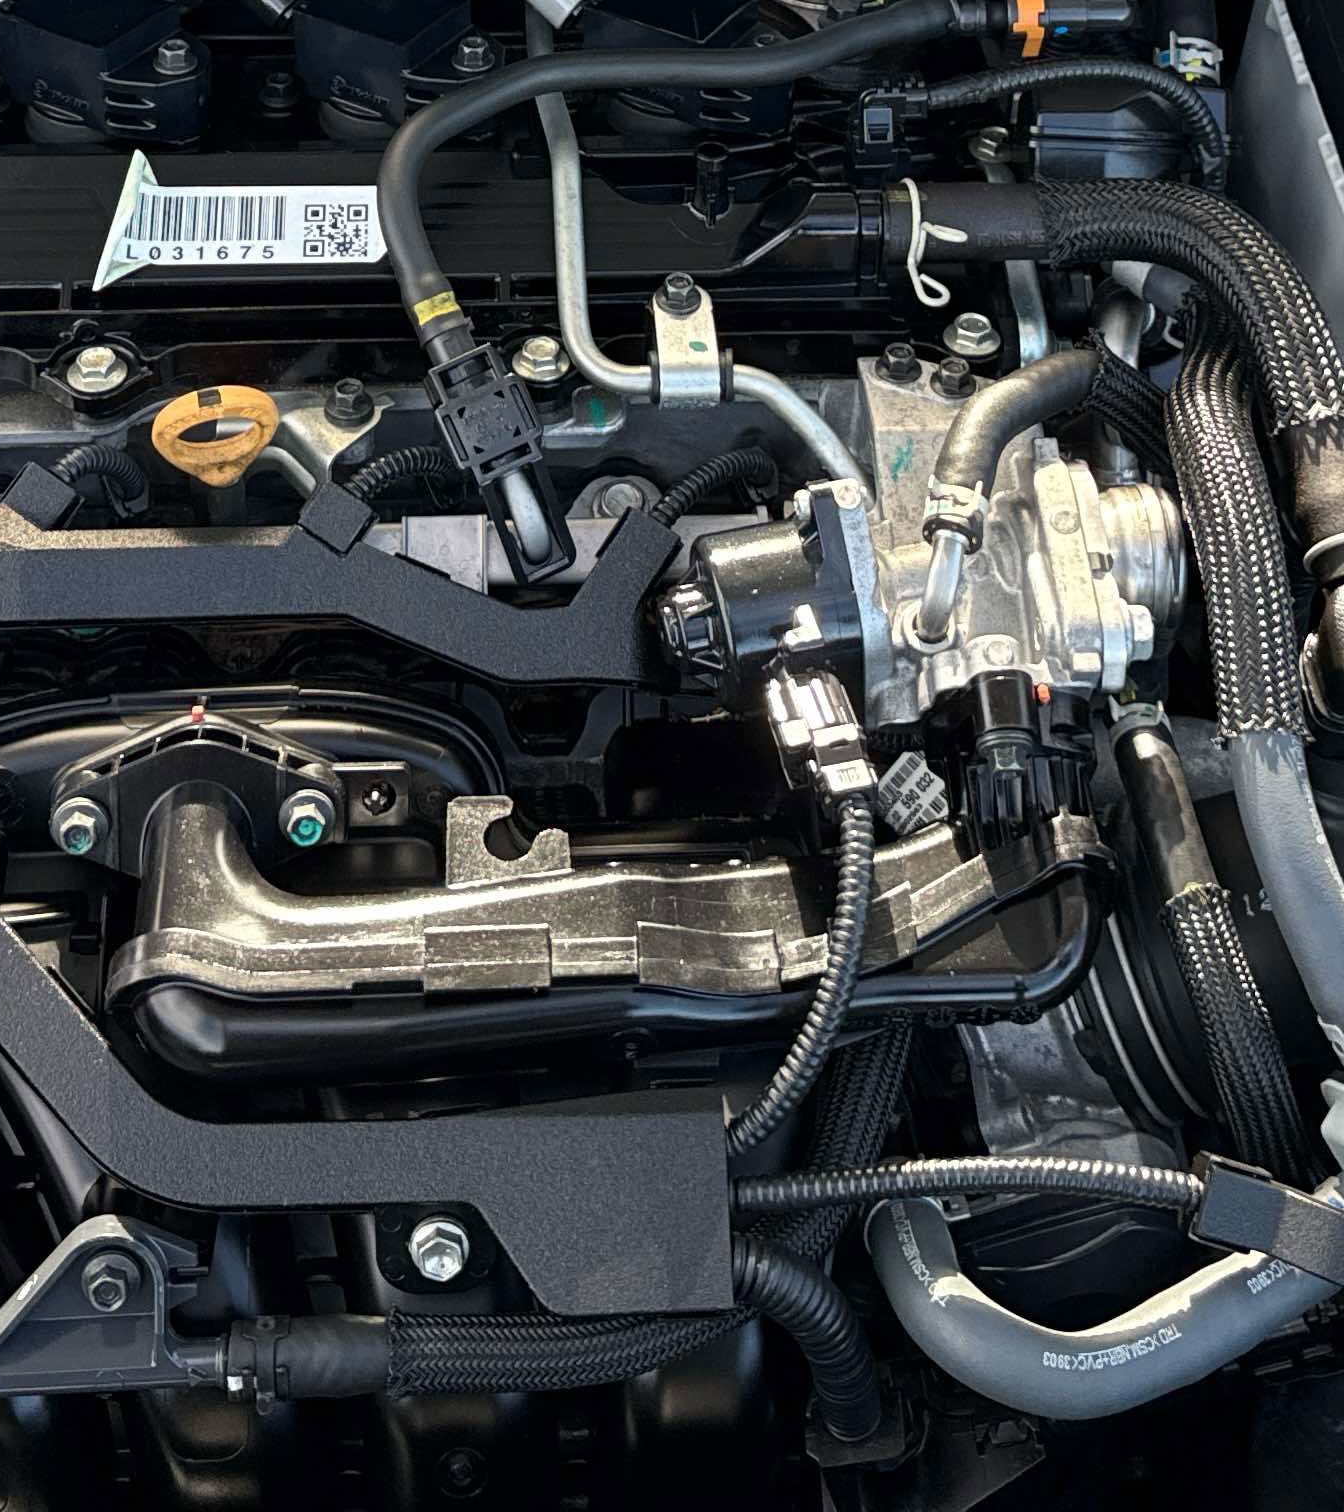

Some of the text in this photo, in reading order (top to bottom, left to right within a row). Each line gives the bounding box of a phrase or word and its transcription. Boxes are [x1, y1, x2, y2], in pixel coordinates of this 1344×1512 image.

[125, 245, 274, 260] L031675
[900, 788, 921, 810] 590
[916, 771, 936, 793] 032
